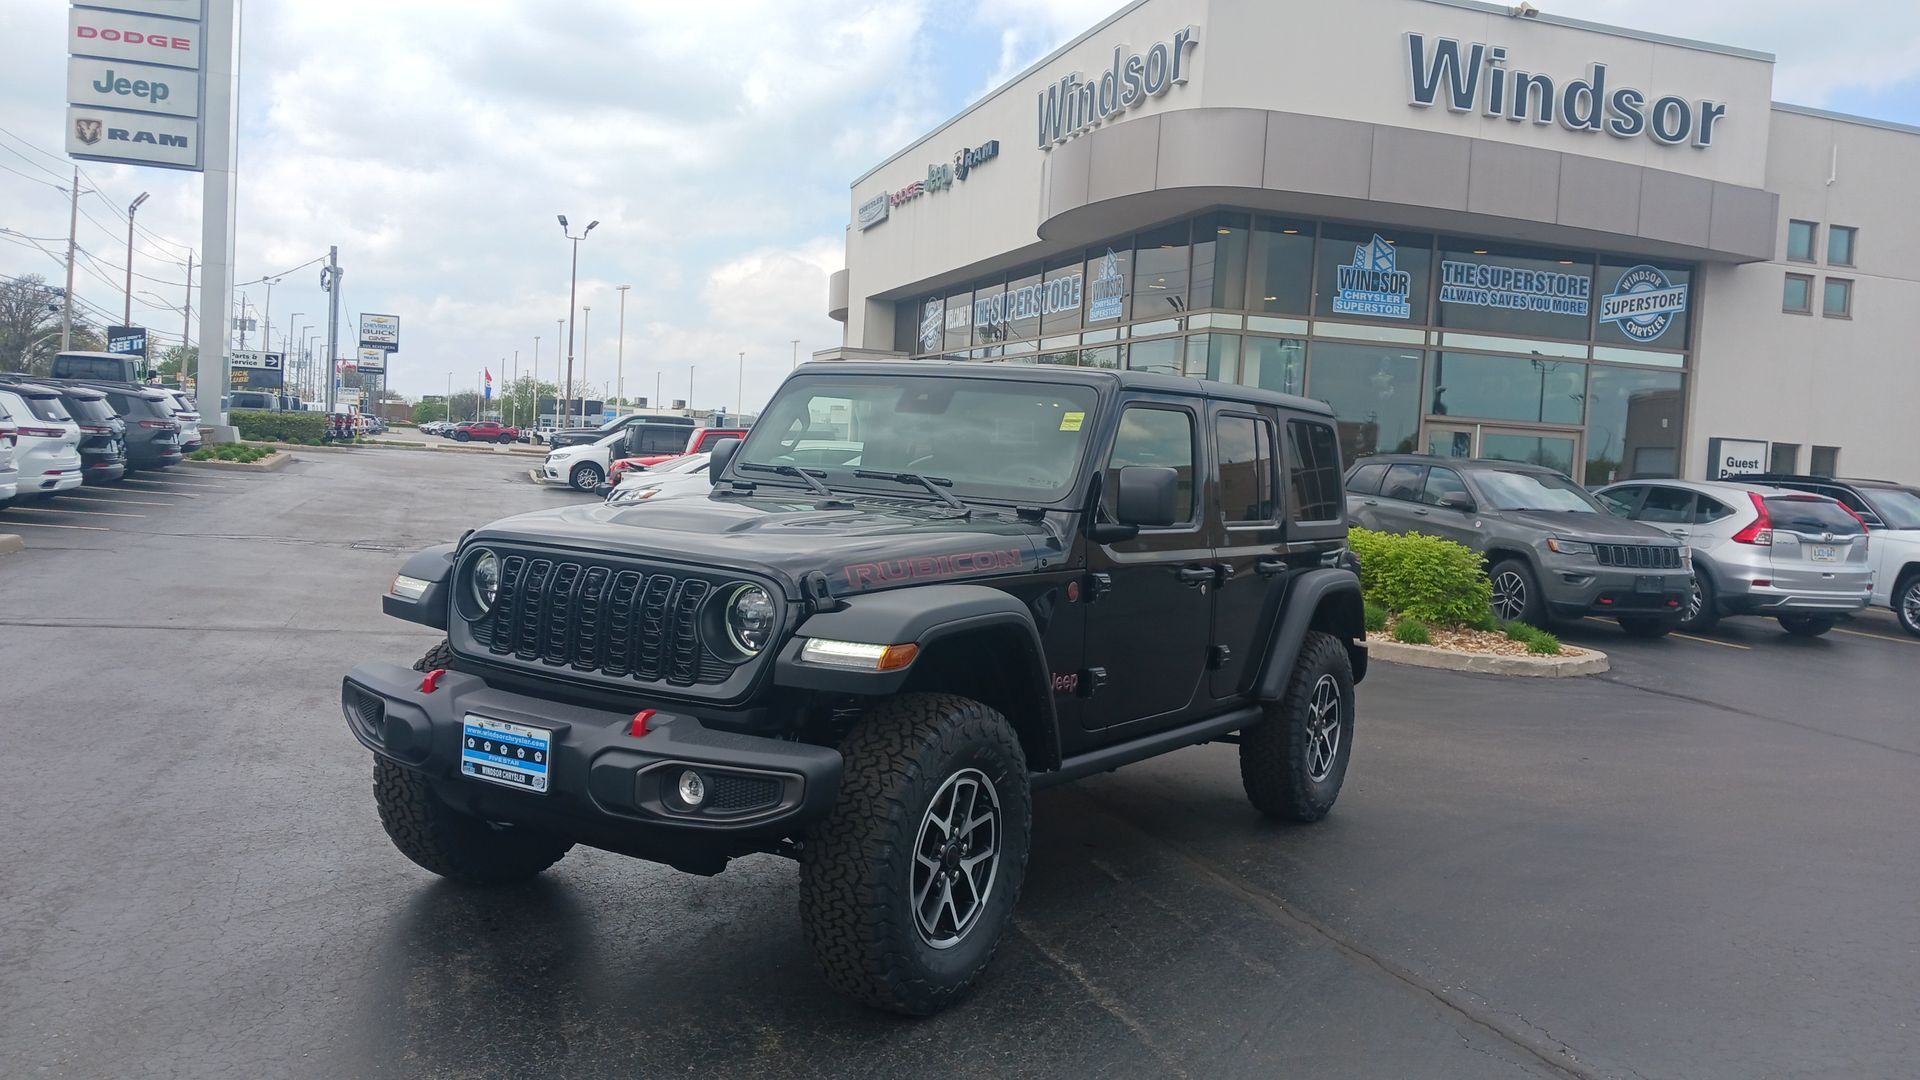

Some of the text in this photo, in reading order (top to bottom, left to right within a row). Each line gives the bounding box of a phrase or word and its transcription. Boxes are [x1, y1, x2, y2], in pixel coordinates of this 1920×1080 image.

[77, 26, 191, 51] DODGE
[93, 69, 170, 104] Jeep
[1038, 25, 1200, 150] Windsor
[1406, 31, 1726, 148] Windsor
[108, 127, 188, 148] RAM
[964, 140, 999, 169] RAM
[924, 164, 953, 193] Jeep
[889, 181, 924, 207] DODGE
[1093, 275, 1123, 302] WINDSOR
[1340, 268, 1408, 294] WINDSOR
[1443, 262, 1589, 298] THE SUPERSTORE
[1622, 271, 1662, 290] WINDSOR
[975, 274, 1082, 326] THE SUPERSTORE
[1094, 299, 1120, 310] CHRYSLER
[1336, 301, 1408, 315] SUPERSTORE
[1344, 291, 1400, 303] CHRYSLER
[1441, 287, 1587, 314] ALWAYS SAVES YOU MORE!
[1604, 292, 1684, 316] SUPERSTORE
[1090, 306, 1121, 320] SUPERSTORE
[1626, 316, 1666, 336] CHRYSLER
[109, 339, 145, 353] SEE IT
[1726, 456, 1759, 469] Guest
[844, 549, 1023, 588] RUBICON
[1050, 672, 1078, 692] Jeep
[466, 727, 546, 748] www.windsorchrysler.com
[488, 755, 520, 766] FIVE STAR
[481, 766, 502, 777] WINDSOR
[502, 768, 526, 783] CHRYSLER
